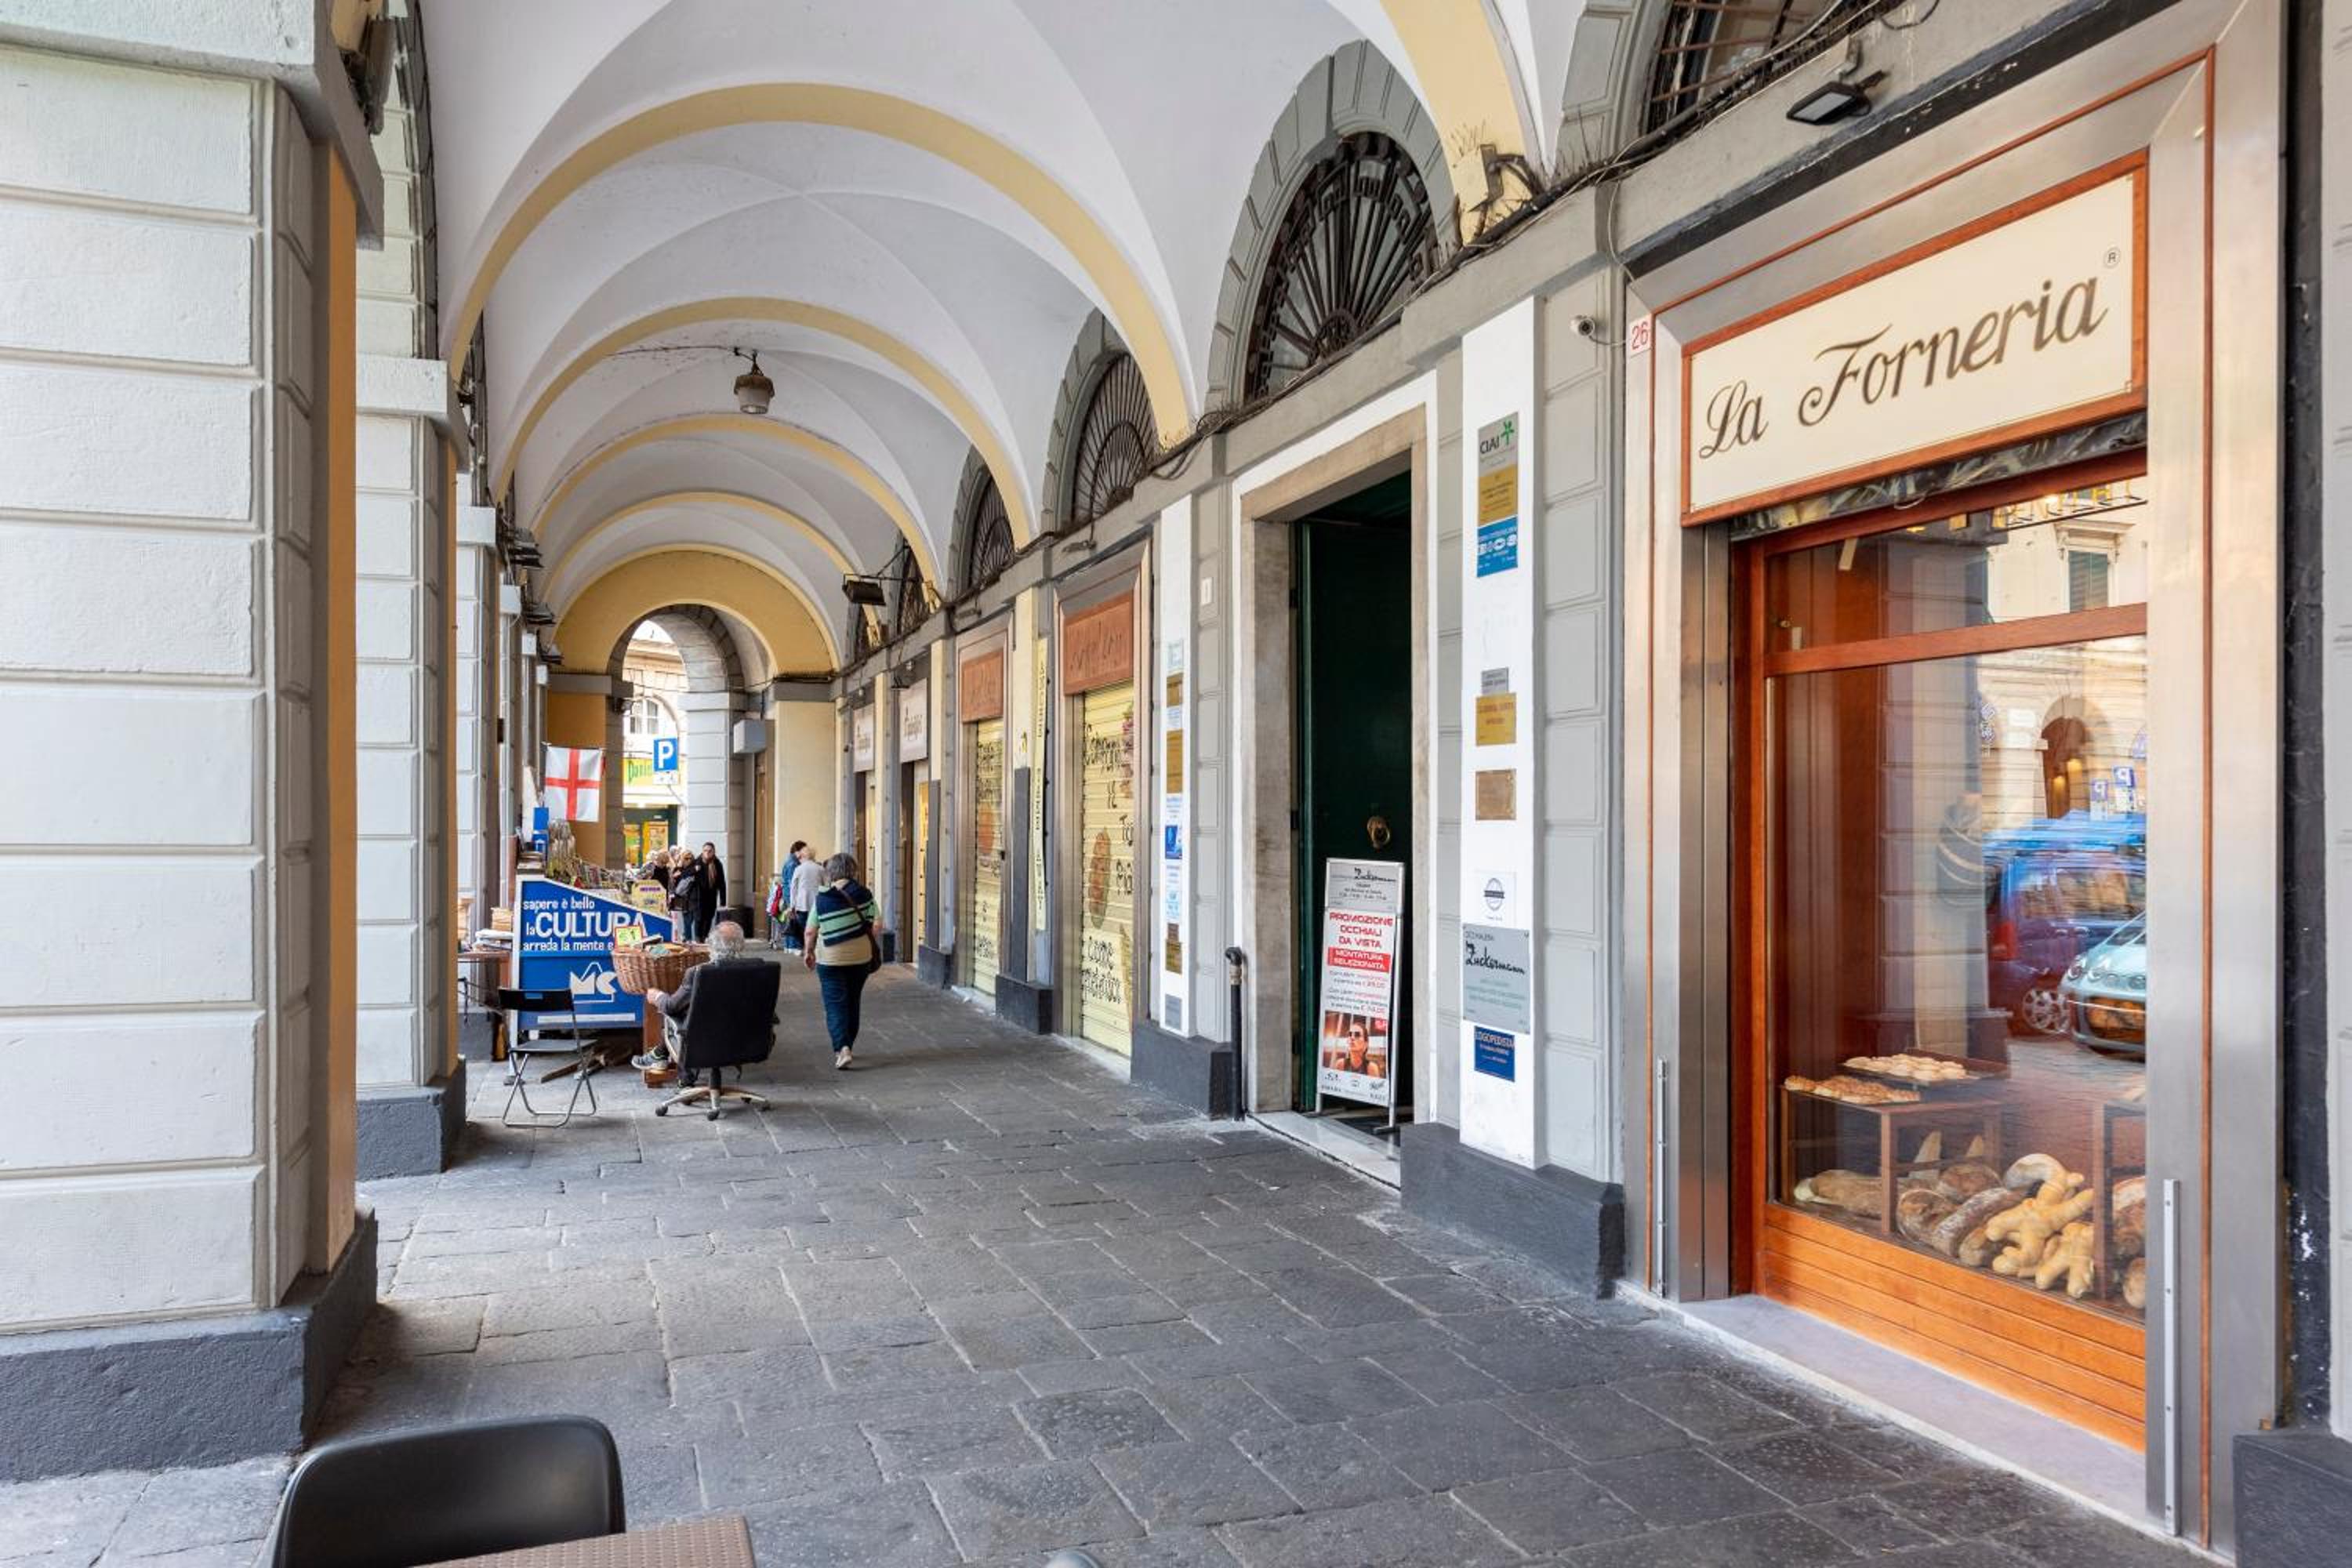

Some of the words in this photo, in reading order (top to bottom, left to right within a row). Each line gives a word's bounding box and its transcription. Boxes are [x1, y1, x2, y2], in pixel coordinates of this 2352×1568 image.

[1632, 321, 1648, 350] 26
[1699, 379, 1769, 459] La
[1798, 276, 2110, 427] Forneria
[658, 741, 673, 769] P
[523, 900, 559, 913] sapere
[562, 898, 569, 910] è
[571, 896, 595, 910] bello
[526, 922, 535, 935] la
[535, 911, 648, 938] CULTURA
[1329, 912, 1394, 927] PROMOZIONE
[1340, 925, 1382, 937] OCCHIALI
[523, 937, 558, 951] arreda
[561, 938, 570, 951] la
[573, 941, 604, 951] mente
[1338, 936, 1352, 946] DA
[1355, 938, 1382, 949] VISTA
